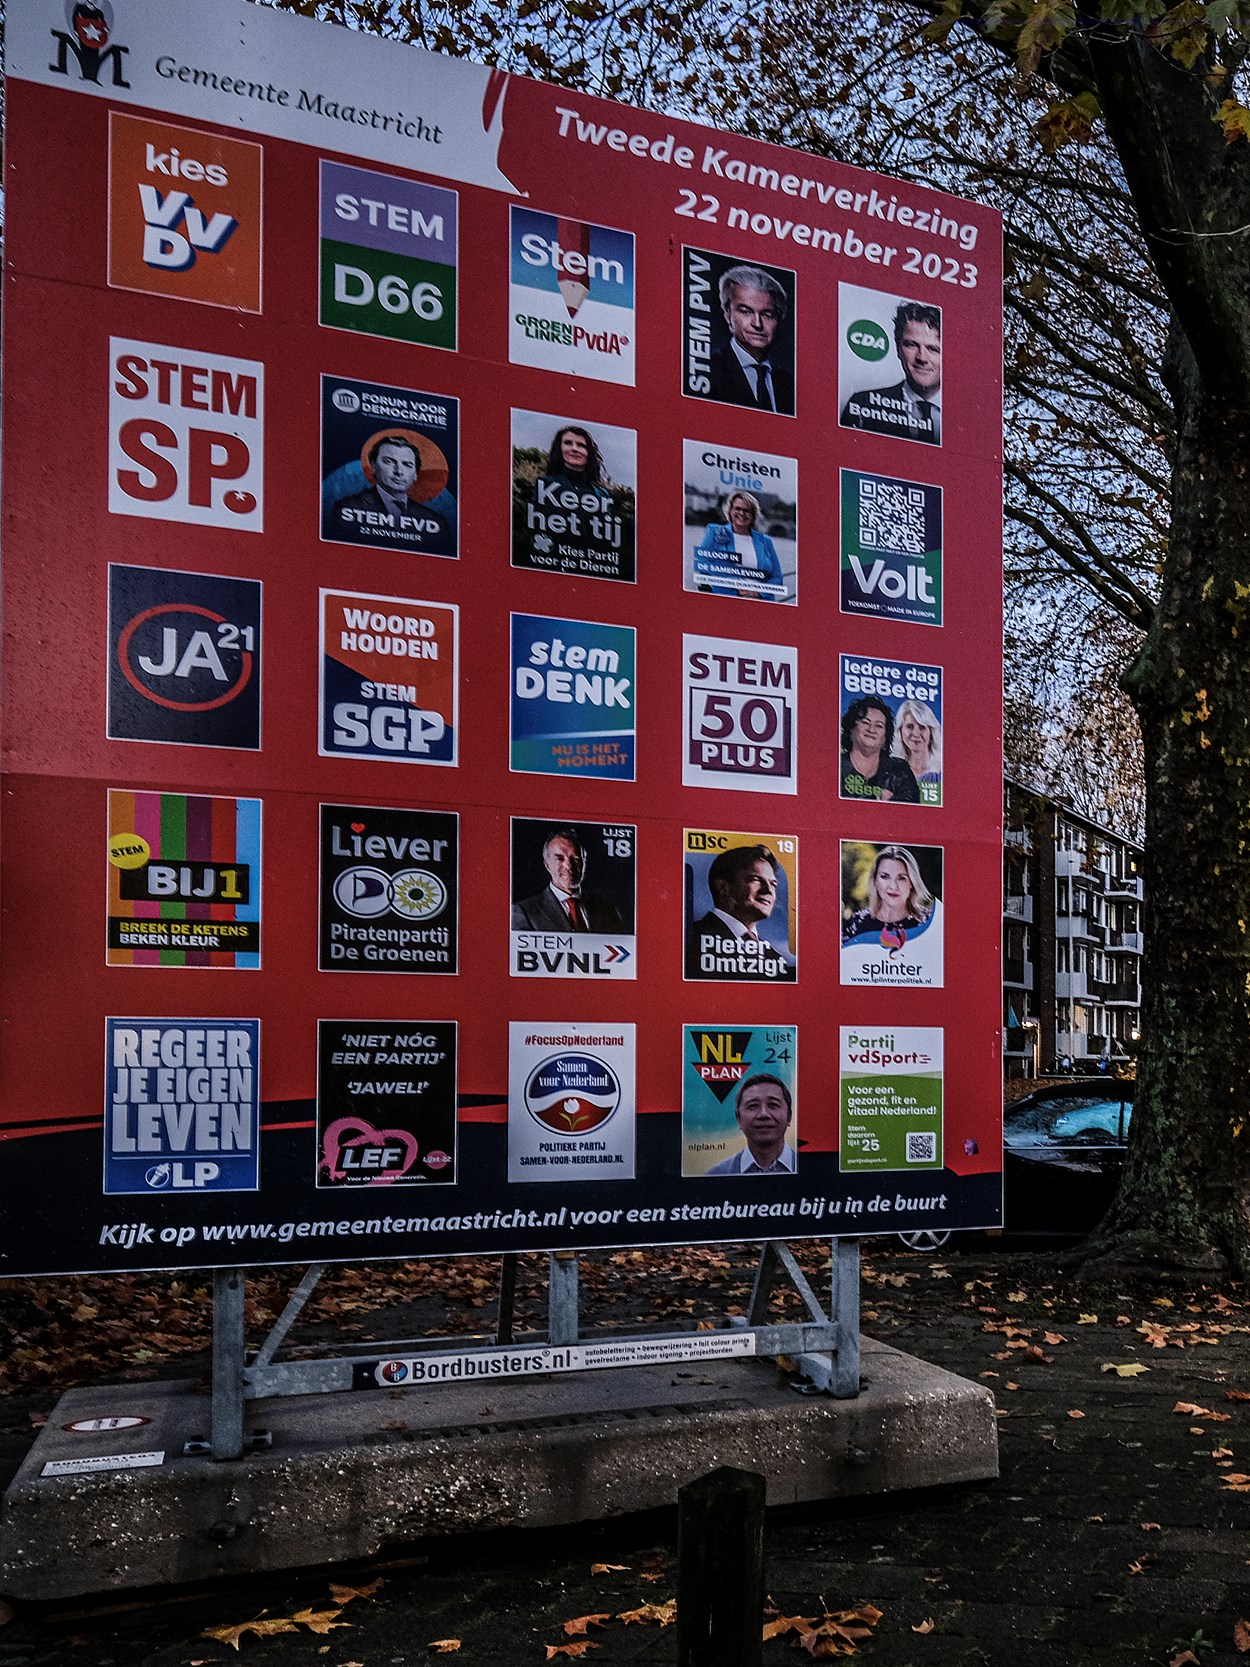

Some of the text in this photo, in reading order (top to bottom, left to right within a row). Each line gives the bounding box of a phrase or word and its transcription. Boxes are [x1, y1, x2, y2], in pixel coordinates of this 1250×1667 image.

[155, 55, 443, 145] Gemeente Maastricht
[145, 142, 229, 187] kies
[555, 106, 979, 251] Tweede Kamerverkiezing
[334, 193, 444, 242] STEM
[674, 188, 978, 289] 22 november 2023
[520, 234, 625, 285] Stem
[334, 263, 444, 322] D66
[515, 313, 573, 335] GROEN
[688, 252, 712, 395] STEM PVV
[525, 327, 573, 347] LINKS
[573, 325, 622, 357] PvdA
[850, 331, 886, 351] CDA
[115, 355, 257, 419] STEM
[361, 392, 448, 417] FORUM VOOR
[869, 391, 913, 414] Henri
[361, 403, 448, 426] DEMOCRATIE
[849, 402, 933, 432] Bontenbal
[702, 452, 781, 479] Christen
[720, 470, 764, 491] Unie
[537, 479, 615, 513] Keer
[341, 507, 441, 534] STEM FVD
[527, 503, 623, 549] het tij
[359, 526, 423, 542] 22 NOVEMBER
[530, 554, 620, 574] voor de Dieren
[558, 544, 620, 566] Kies Partij
[729, 554, 739, 562] IN
[848, 554, 936, 604] Volt
[343, 607, 435, 637] WOORD
[138, 622, 255, 682] JA21
[341, 631, 439, 660] HOUDEN
[528, 638, 620, 673] stem
[688, 652, 792, 690] STEM
[844, 659, 939, 686] Iedere dag
[360, 681, 417, 703] STEM
[516, 666, 631, 709] DENK
[844, 674, 939, 702] BBBeter
[333, 702, 445, 753] SGP
[700, 694, 778, 743] 50
[551, 742, 621, 755] NU IS HET
[701, 743, 776, 769] PLUS
[557, 753, 628, 767] MOMENT
[922, 789, 938, 801] 15
[332, 824, 448, 861] Liever
[602, 827, 633, 838] LIJST
[111, 845, 144, 858] STEM
[603, 838, 632, 858] 18
[776, 840, 794, 854] 19
[147, 865, 243, 899] BIJ1
[119, 921, 249, 937] BREEK DE KETENS
[331, 922, 449, 947] Piratenpartij
[119, 933, 220, 948] BEKEN KLEUR
[517, 934, 573, 950] STEM
[700, 934, 771, 955] Pieter
[330, 943, 449, 963] De Groenen
[517, 950, 611, 974] BVNL
[700, 953, 788, 977] Omtzigt
[862, 959, 923, 978] splinter
[113, 1028, 252, 1068] REGEER
[524, 1034, 624, 1047] #FocusOpNederland
[701, 1033, 742, 1063] NL
[765, 1031, 792, 1045] Lijst
[848, 1034, 895, 1052] Partij
[331, 1052, 372, 1065] EEN
[556, 1060, 588, 1073] Samen
[763, 1047, 791, 1064] 24
[848, 1050, 918, 1067] vdSport
[538, 1074, 609, 1088] voor Nederland
[701, 1066, 742, 1079] PLAN
[112, 1067, 252, 1104] JE EIGEN
[847, 1086, 895, 1095] Voor een
[847, 1095, 917, 1108] gezond, fit en
[847, 1105, 937, 1116] vitaal Nederland!
[112, 1103, 252, 1152] LEVEN
[539, 1141, 606, 1152] POLITIEKE PARTIJ
[688, 1143, 726, 1152] nlplan.nl
[861, 1138, 880, 1152] 25
[342, 1147, 403, 1169] LEF
[519, 1154, 624, 1166] SAMEN-VOOR-NEDERLAND.NL
[172, 1161, 221, 1187] LP
[99, 1193, 948, 1249] Kijk op www.gemeentemaastricht.nl voor een stembureau bij u in de buurt
[585, 1346, 636, 1356] autobelettering
[642, 1342, 693, 1352] bewegwijzering
[711, 1339, 730, 1347] colour
[585, 1347, 733, 1365] gevelreclame indoor signing projectborden
